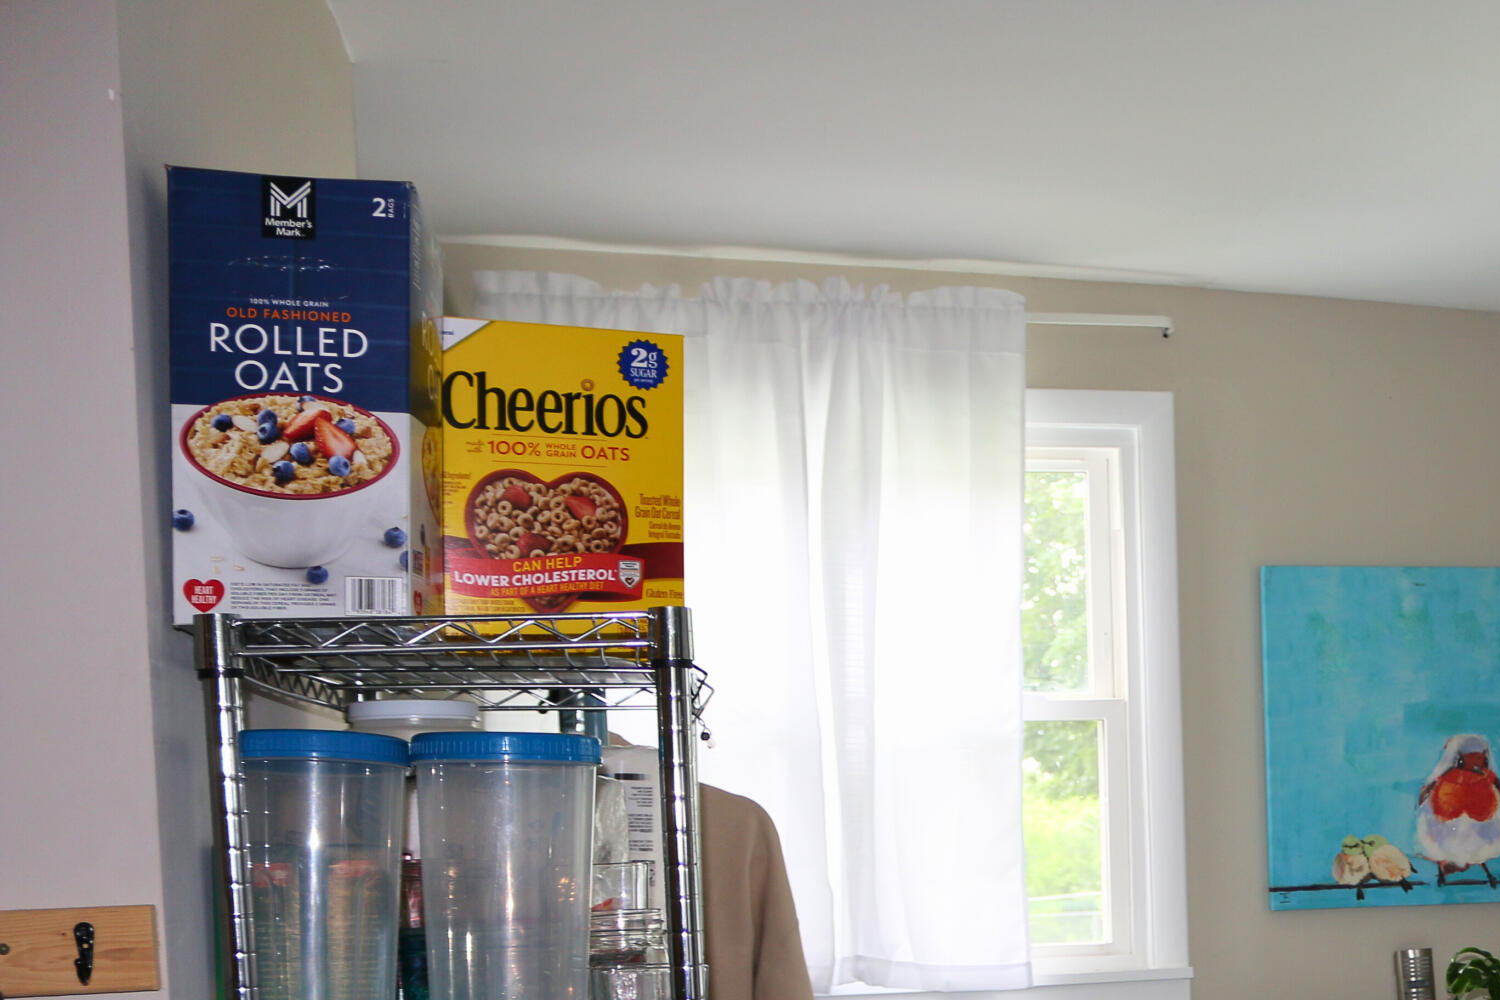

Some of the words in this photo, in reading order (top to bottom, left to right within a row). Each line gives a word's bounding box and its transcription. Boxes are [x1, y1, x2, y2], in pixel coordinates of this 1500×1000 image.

[372, 197, 387, 217] 2
[265, 217, 313, 229] Member's
[276, 227, 302, 237] Mark
[303, 300, 329, 308] GRAIN
[226, 306, 258, 319] OLD
[263, 308, 352, 323] FASHIONED
[209, 322, 369, 358] ROLLED
[630, 347, 658, 369] 2g
[234, 359, 344, 393] OATS
[630, 367, 658, 379] SUGAR
[442, 370, 649, 439] Cheerios
[487, 440, 541, 457] 100%
[545, 442, 577, 451] WHOLE
[546, 450, 577, 458] GRAIN
[580, 445, 630, 462] OATS
[513, 559, 541, 573] CAN
[547, 556, 581, 570] HELP
[453, 570, 510, 588] LOWER
[512, 569, 614, 587] CHOLESTEROL
[502, 586, 518, 596] PART
[520, 586, 529, 595] OF
[537, 584, 558, 594] HEART
[560, 582, 587, 593] HEALTHY
[590, 582, 604, 591] DIET
[645, 588, 667, 599] Gluten
